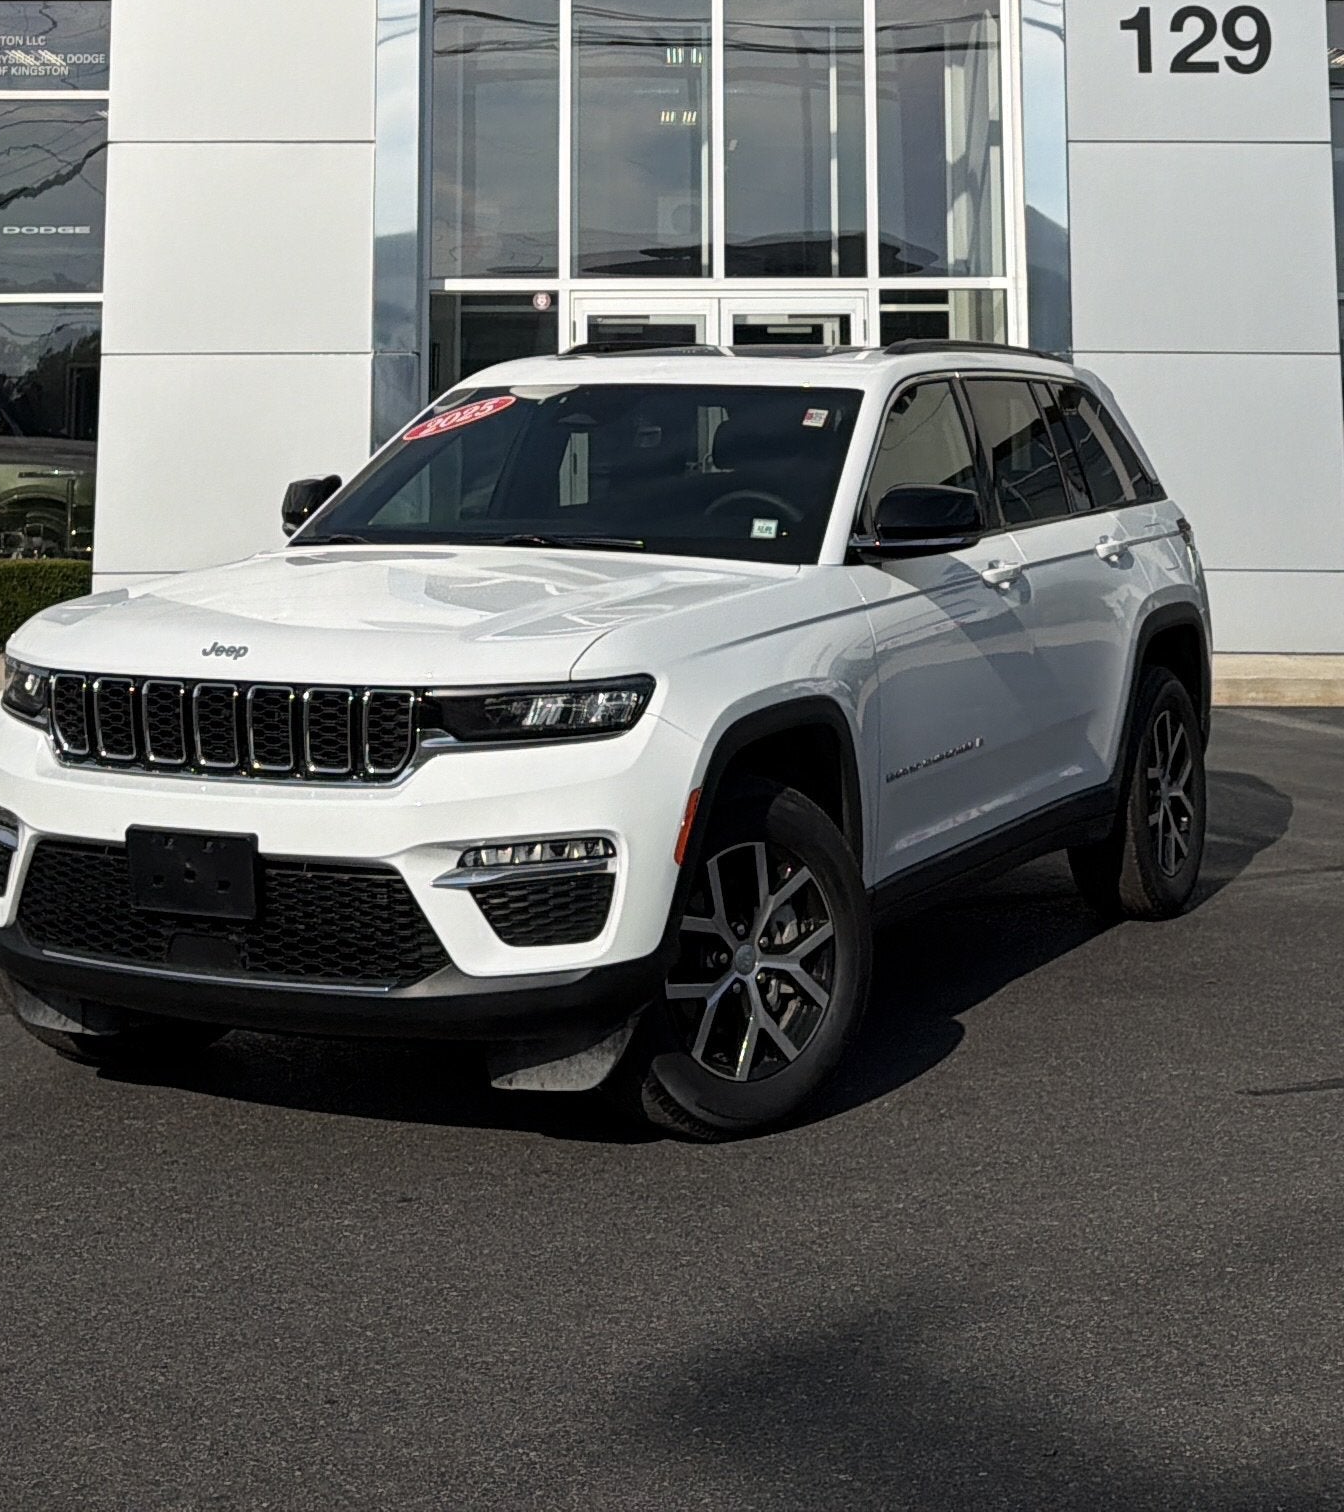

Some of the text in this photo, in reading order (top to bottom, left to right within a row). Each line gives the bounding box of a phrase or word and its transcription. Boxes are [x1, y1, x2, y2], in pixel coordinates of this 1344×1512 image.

[26, 36, 46, 45] LLC
[1120, 5, 1272, 74] 129
[38, 54, 65, 65] JEP
[67, 54, 105, 64] DODGE
[11, 66, 68, 76] KINGSTON
[3, 226, 90, 234] DODGE
[418, 401, 496, 437] 2025
[201, 641, 249, 660] Jeep
